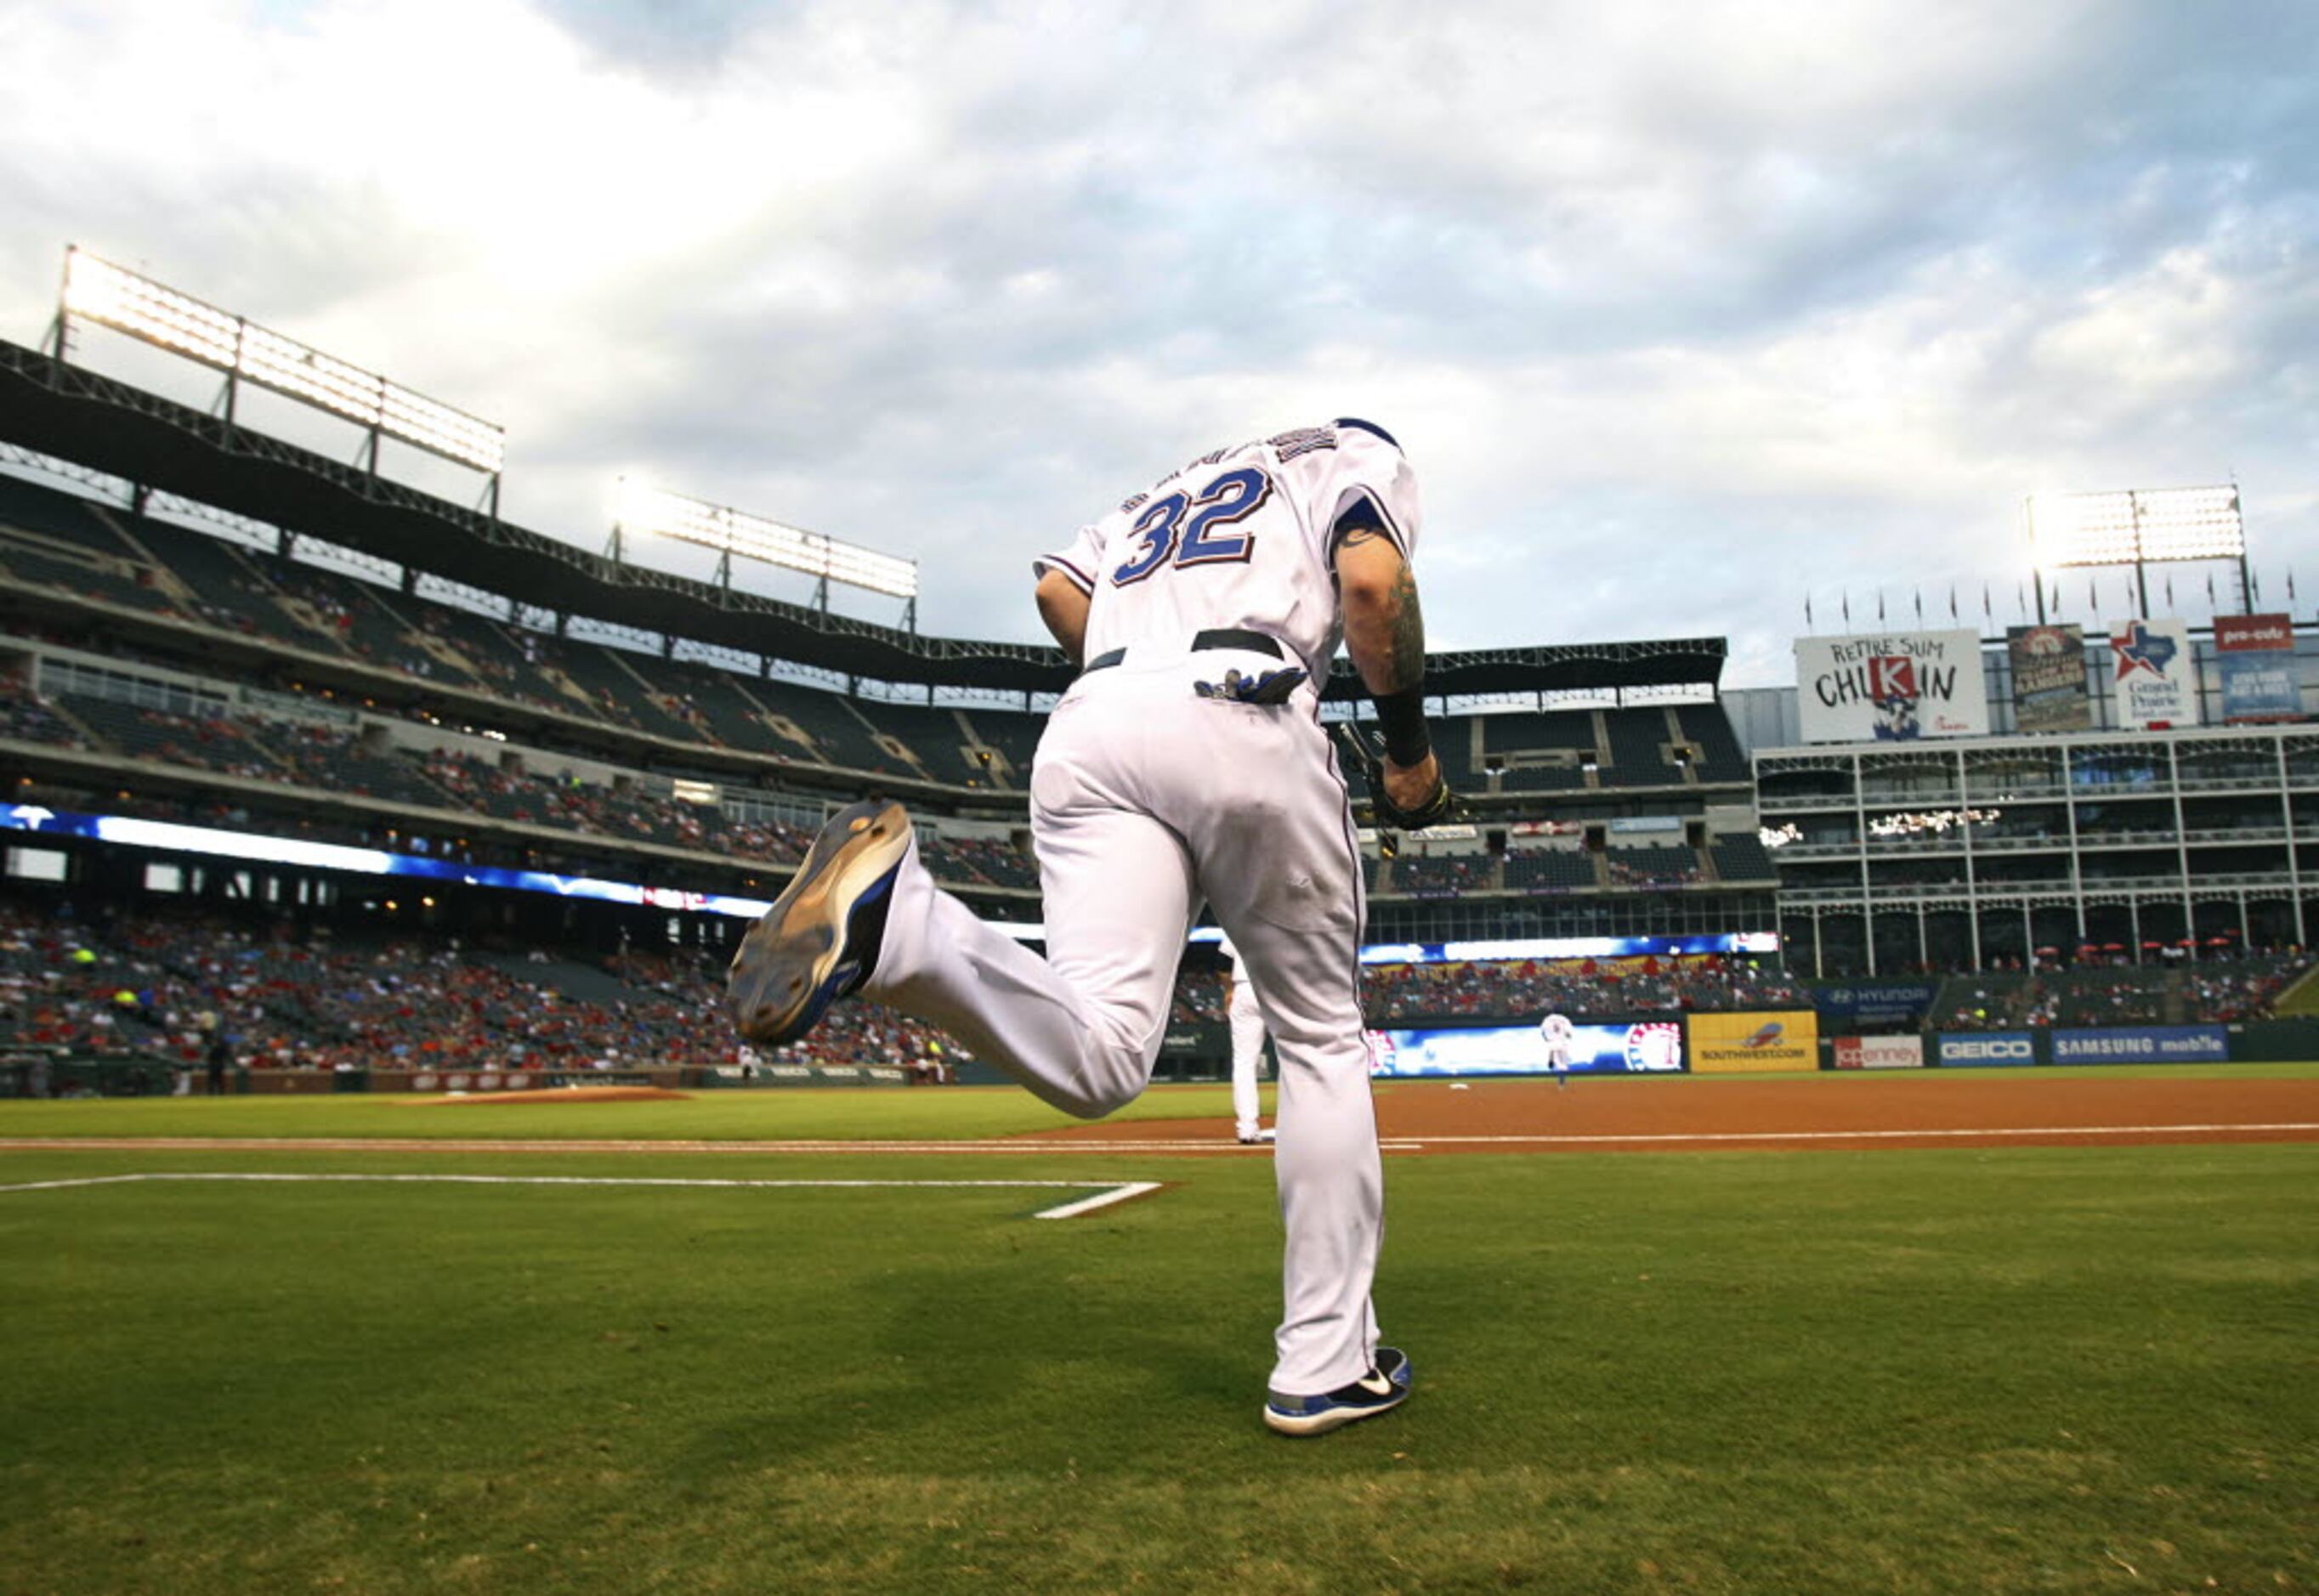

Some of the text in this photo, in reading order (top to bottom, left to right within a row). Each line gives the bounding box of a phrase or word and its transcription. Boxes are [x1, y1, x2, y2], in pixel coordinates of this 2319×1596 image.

[1110, 464, 1274, 589] 32
[1830, 637, 1944, 664] RETIRE SUM
[1858, 988, 1928, 1002] HYUNDAI
[1941, 1040, 2033, 1059] GEICO
[2056, 1038, 2154, 1056] SAMSUNG
